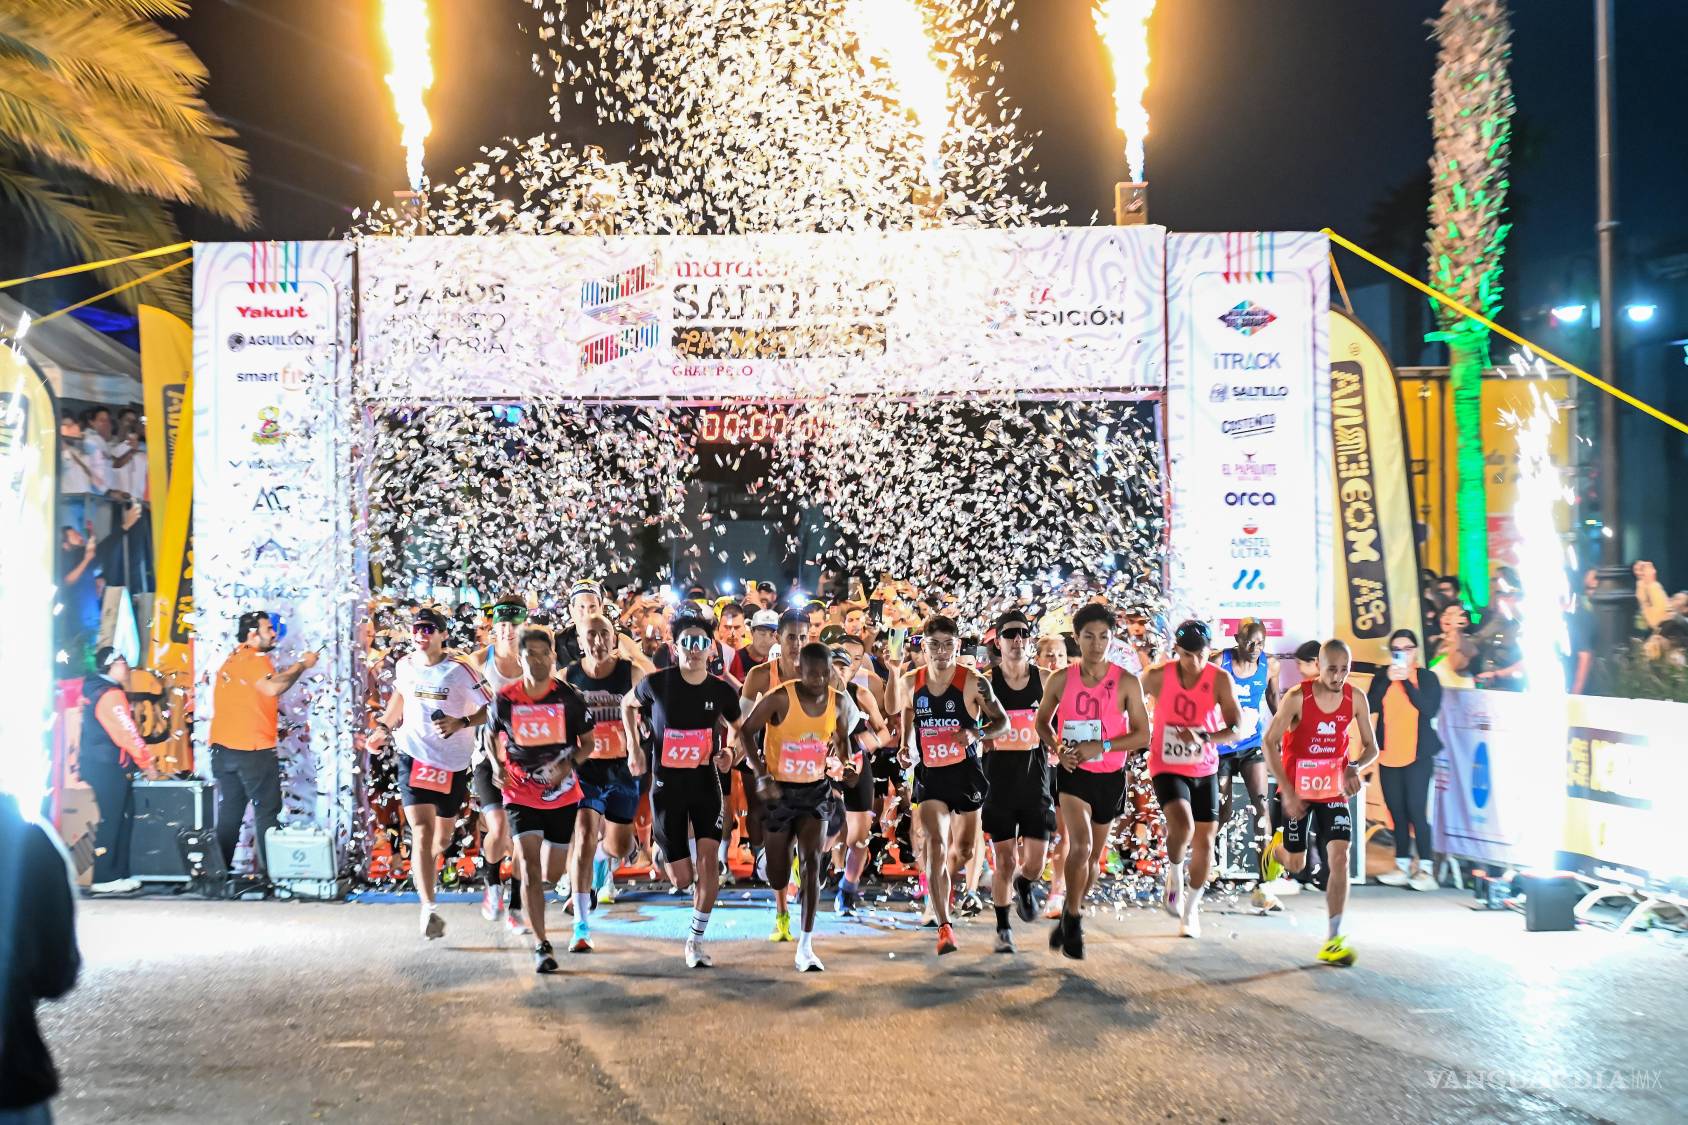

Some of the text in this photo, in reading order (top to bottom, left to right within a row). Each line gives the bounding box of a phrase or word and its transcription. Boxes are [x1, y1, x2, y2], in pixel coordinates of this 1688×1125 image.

[236, 306, 309, 319] Yakult
[237, 372, 279, 383] smart
[1232, 386, 1288, 397] SALTILLO
[1225, 492, 1275, 506] orca
[921, 716, 960, 728] MÉXICO
[668, 746, 700, 761] 473
[927, 743, 960, 759] 384
[783, 758, 816, 775] 579
[416, 767, 448, 785] 228
[1300, 775, 1332, 791] 502
